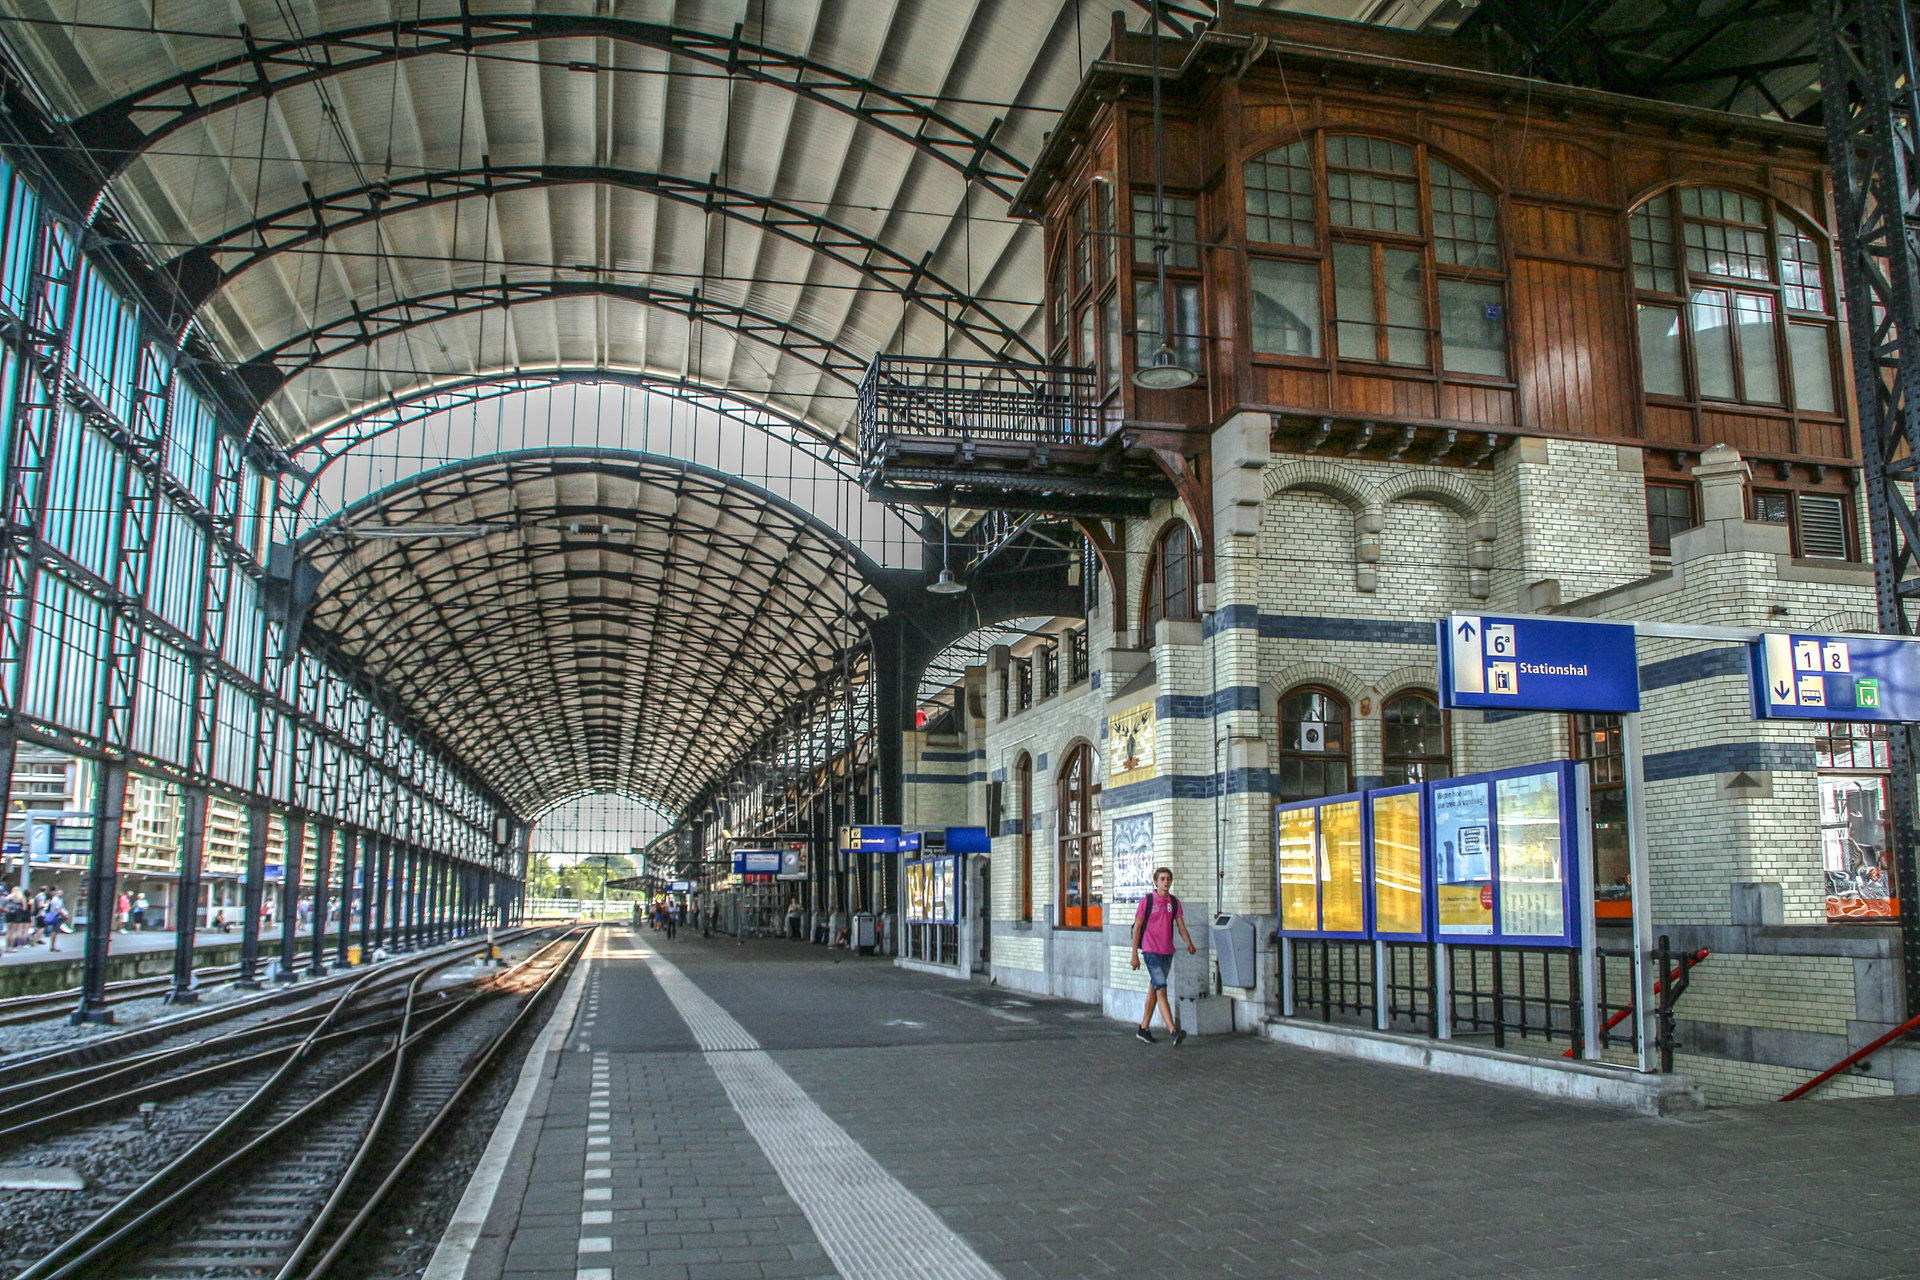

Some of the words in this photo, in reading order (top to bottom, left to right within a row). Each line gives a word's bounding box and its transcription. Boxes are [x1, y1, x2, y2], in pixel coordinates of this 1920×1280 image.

[1494, 635, 1511, 653] 6a
[1520, 662, 1588, 676] Stationshal
[1804, 652, 1811, 668] 1
[1831, 653, 1842, 669] 8
